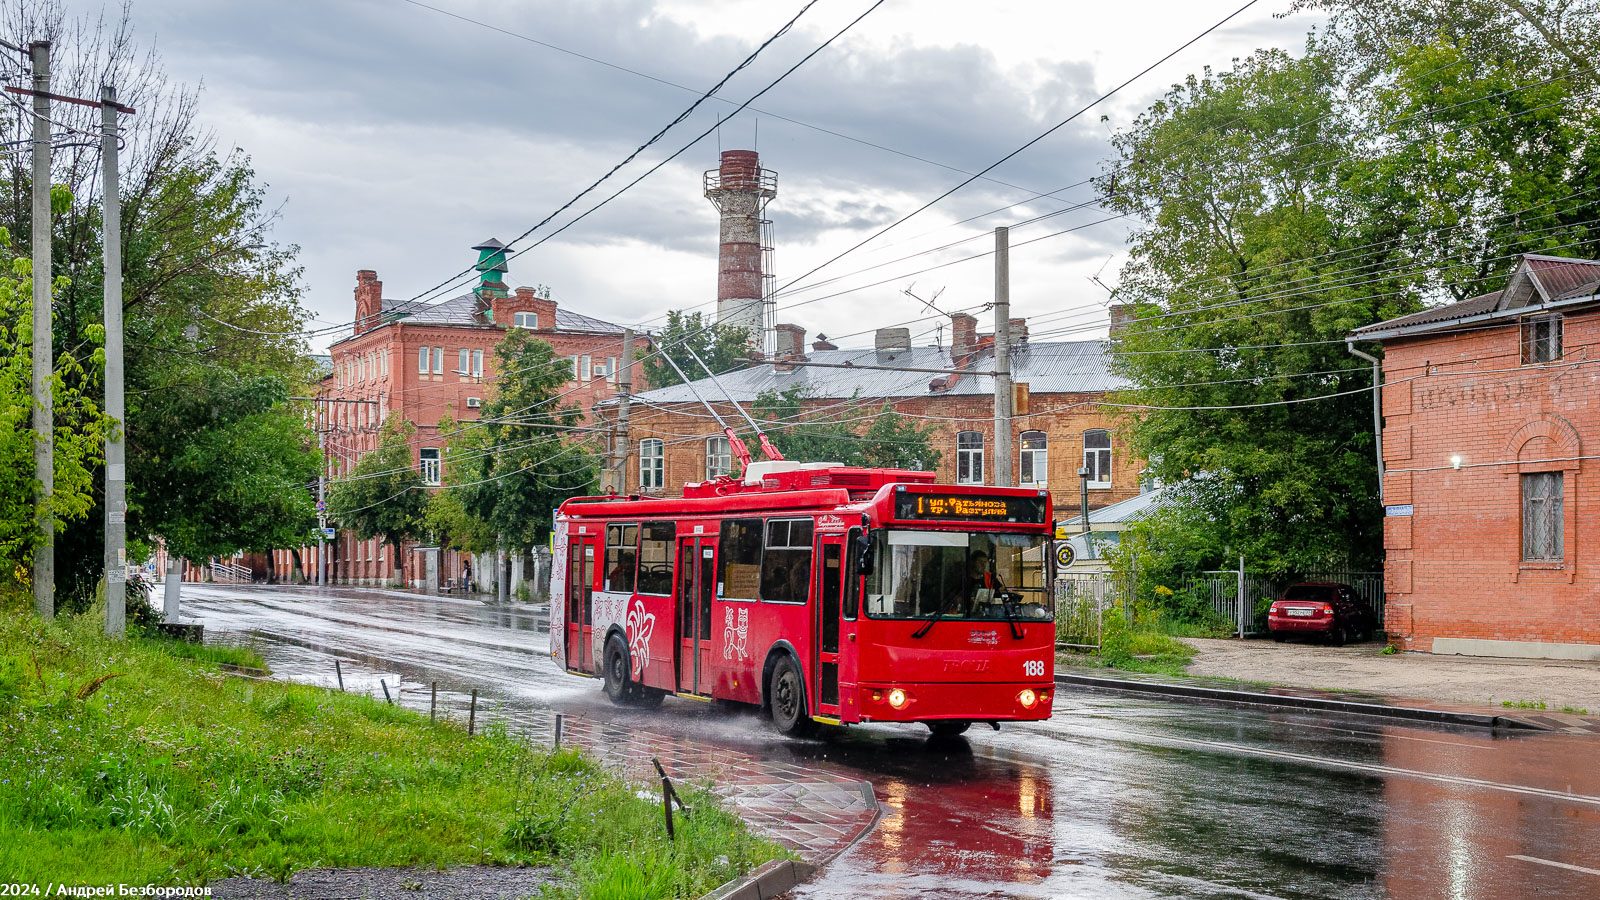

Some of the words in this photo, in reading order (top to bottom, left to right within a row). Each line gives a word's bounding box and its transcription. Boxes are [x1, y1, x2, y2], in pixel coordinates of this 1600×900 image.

[917, 497, 923, 514] 1
[876, 595, 885, 612] 1
[1022, 660, 1045, 677] 188
